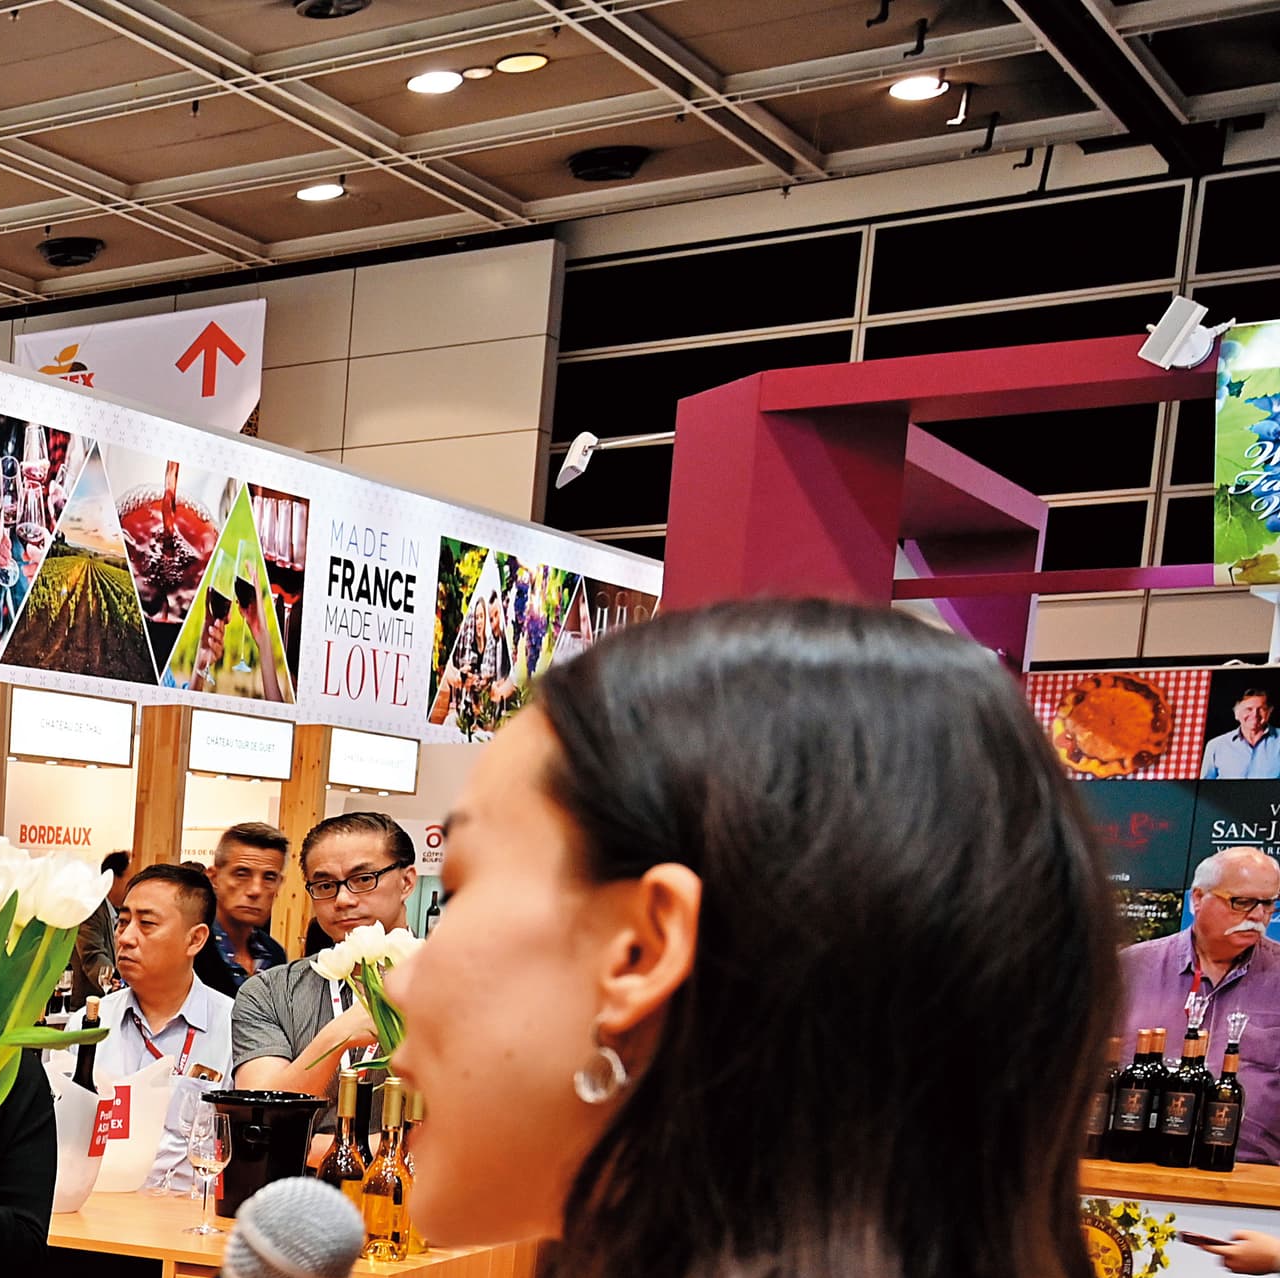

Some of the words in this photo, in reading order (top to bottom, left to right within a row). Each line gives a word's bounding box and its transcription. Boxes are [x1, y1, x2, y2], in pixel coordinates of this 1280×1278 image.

[330, 519, 395, 566] MADE
[402, 537, 420, 568] IN
[327, 555, 417, 616] FRANCE
[323, 600, 371, 643] MADE
[375, 611, 416, 647] WITH
[320, 638, 410, 708] LOVE
[19, 823, 92, 847] BORDEAUX
